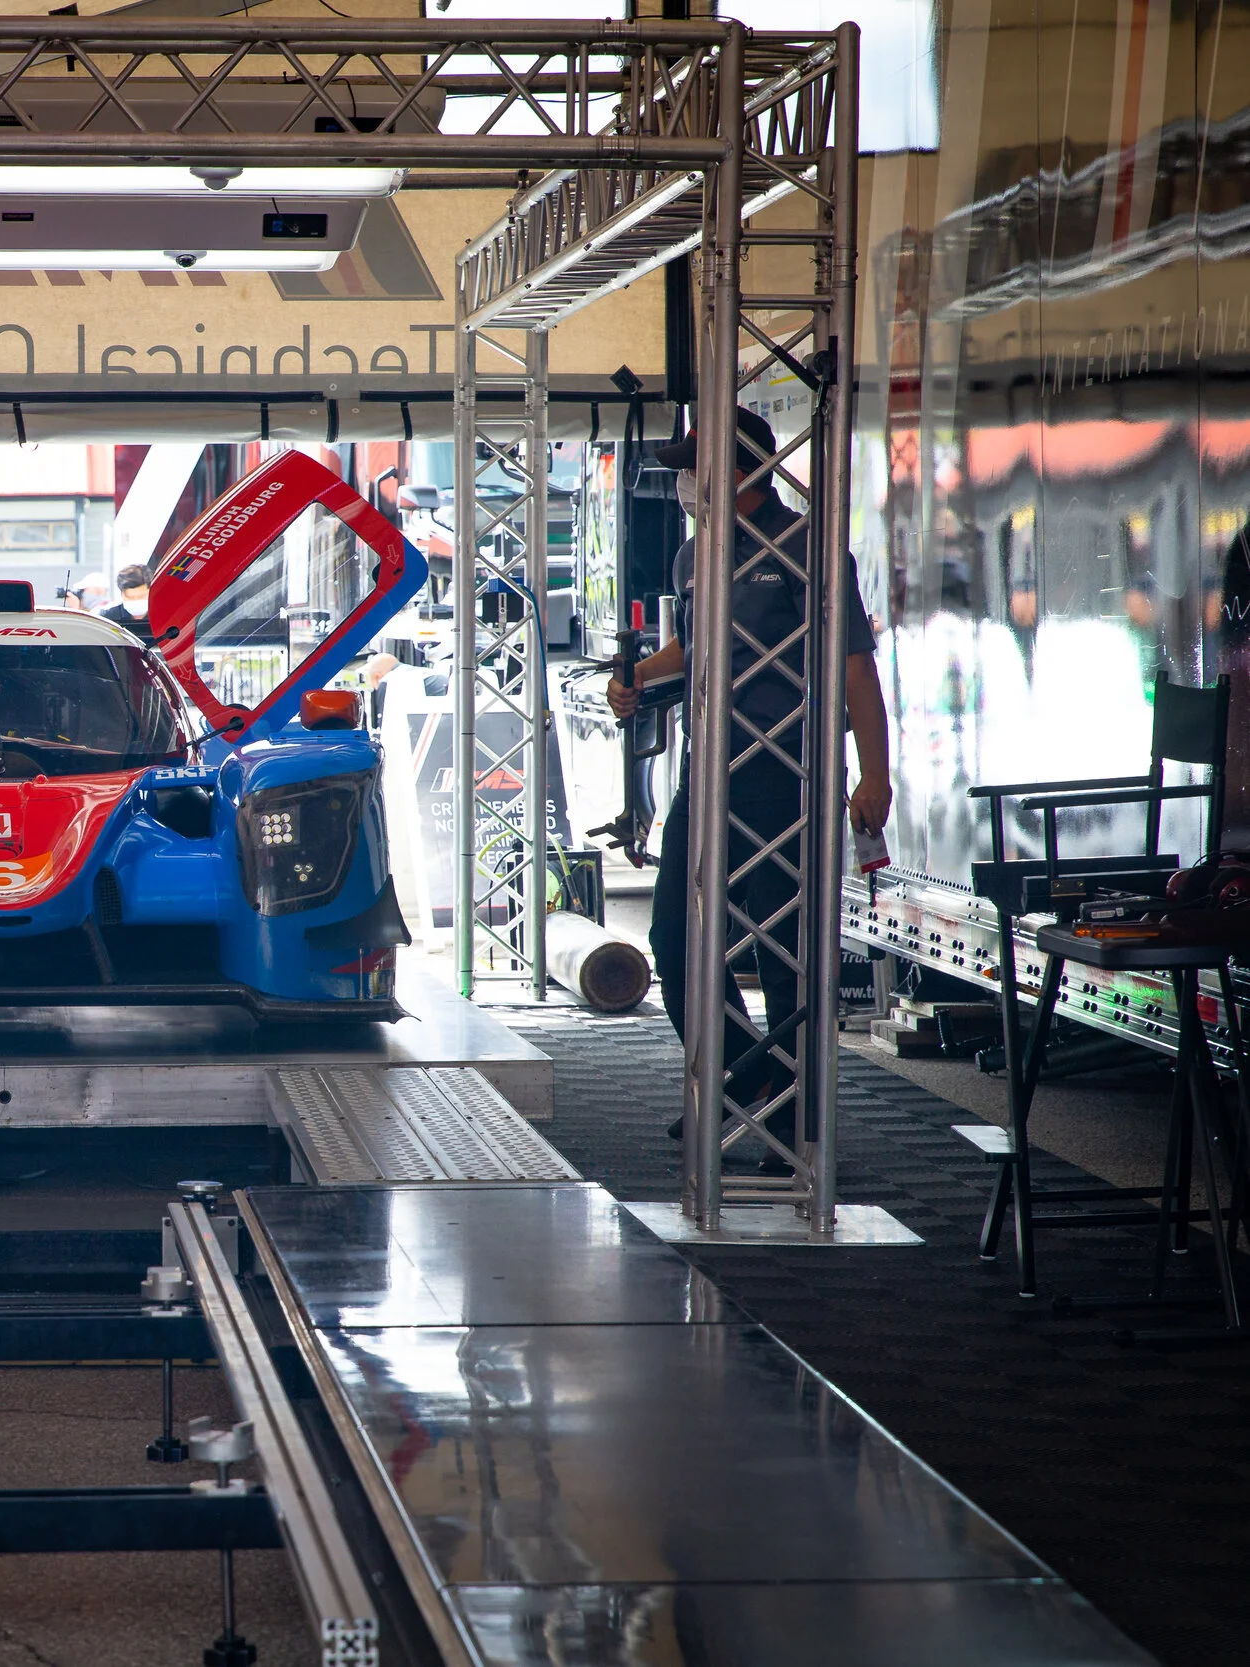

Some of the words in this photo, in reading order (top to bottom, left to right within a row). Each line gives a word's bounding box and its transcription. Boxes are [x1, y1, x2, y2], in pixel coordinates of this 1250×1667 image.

[197, 481, 285, 560] D.GOLDBURG
[186, 505, 243, 555] R.LINDH
[155, 766, 219, 780] SKF
[479, 799, 556, 815] MEMBS
[474, 815, 556, 832] PERMITD
[842, 951, 871, 963] Truc
